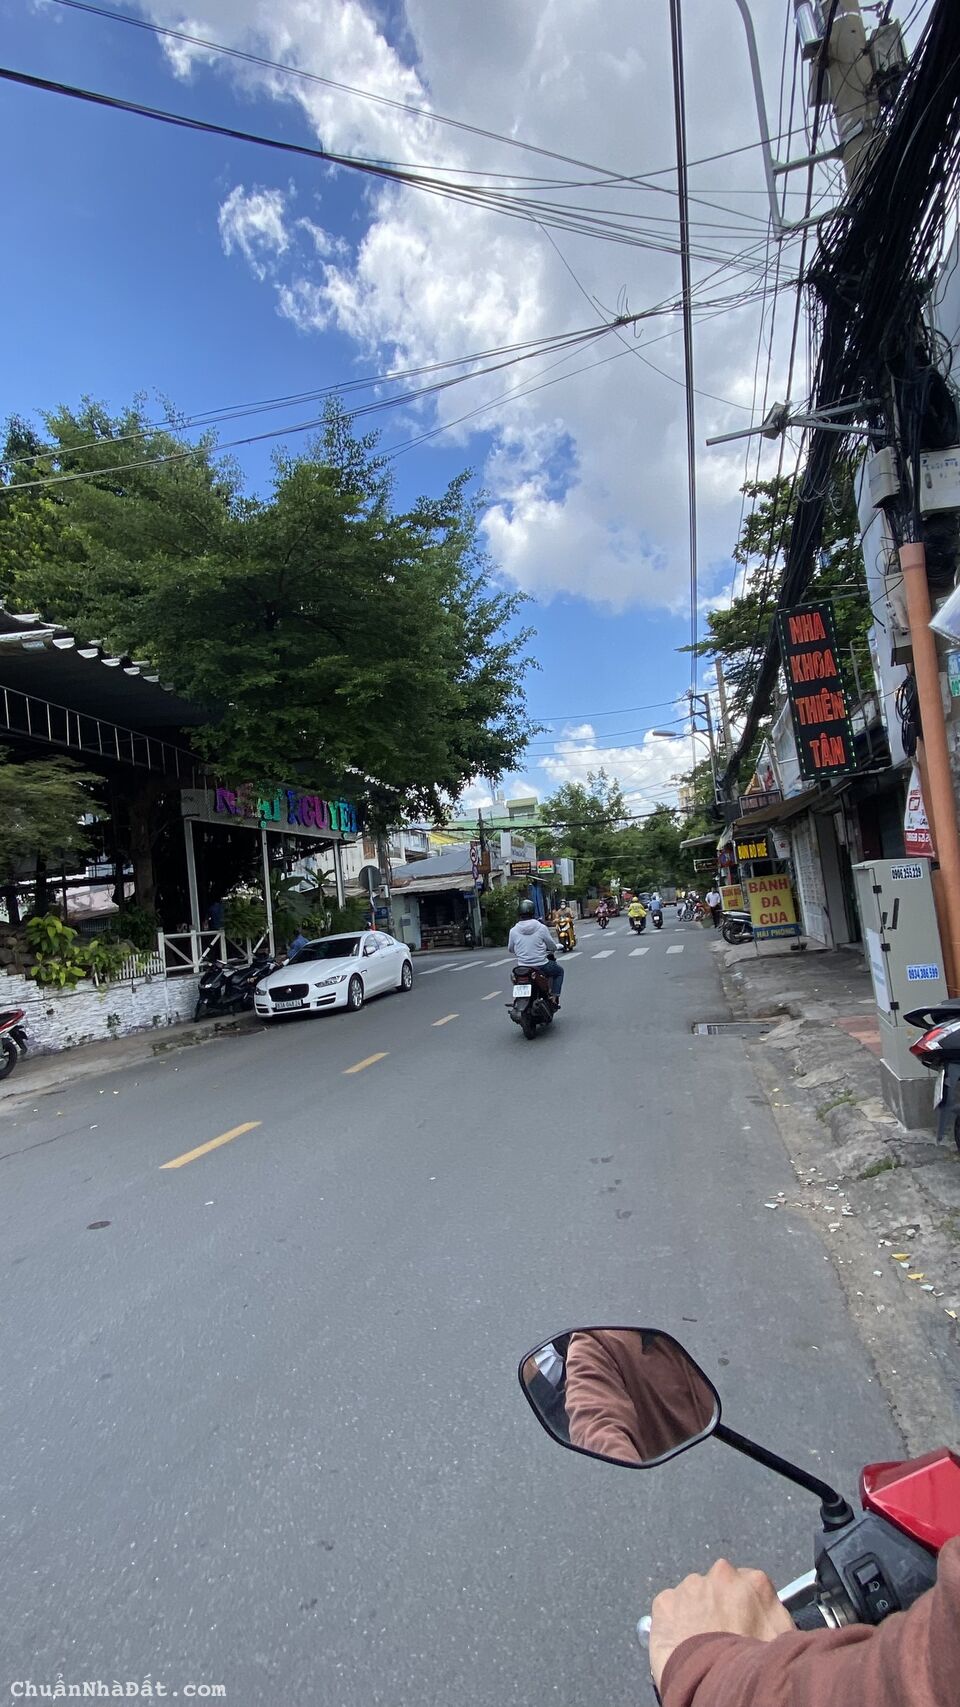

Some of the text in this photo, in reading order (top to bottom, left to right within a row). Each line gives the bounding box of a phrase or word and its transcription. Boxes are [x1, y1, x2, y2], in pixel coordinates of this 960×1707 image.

[788, 612, 826, 645] NHA
[789, 648, 837, 683] KHOA
[795, 687, 846, 726] THIÊN
[809, 732, 846, 768] TÂN
[760, 911, 789, 925] CUA
